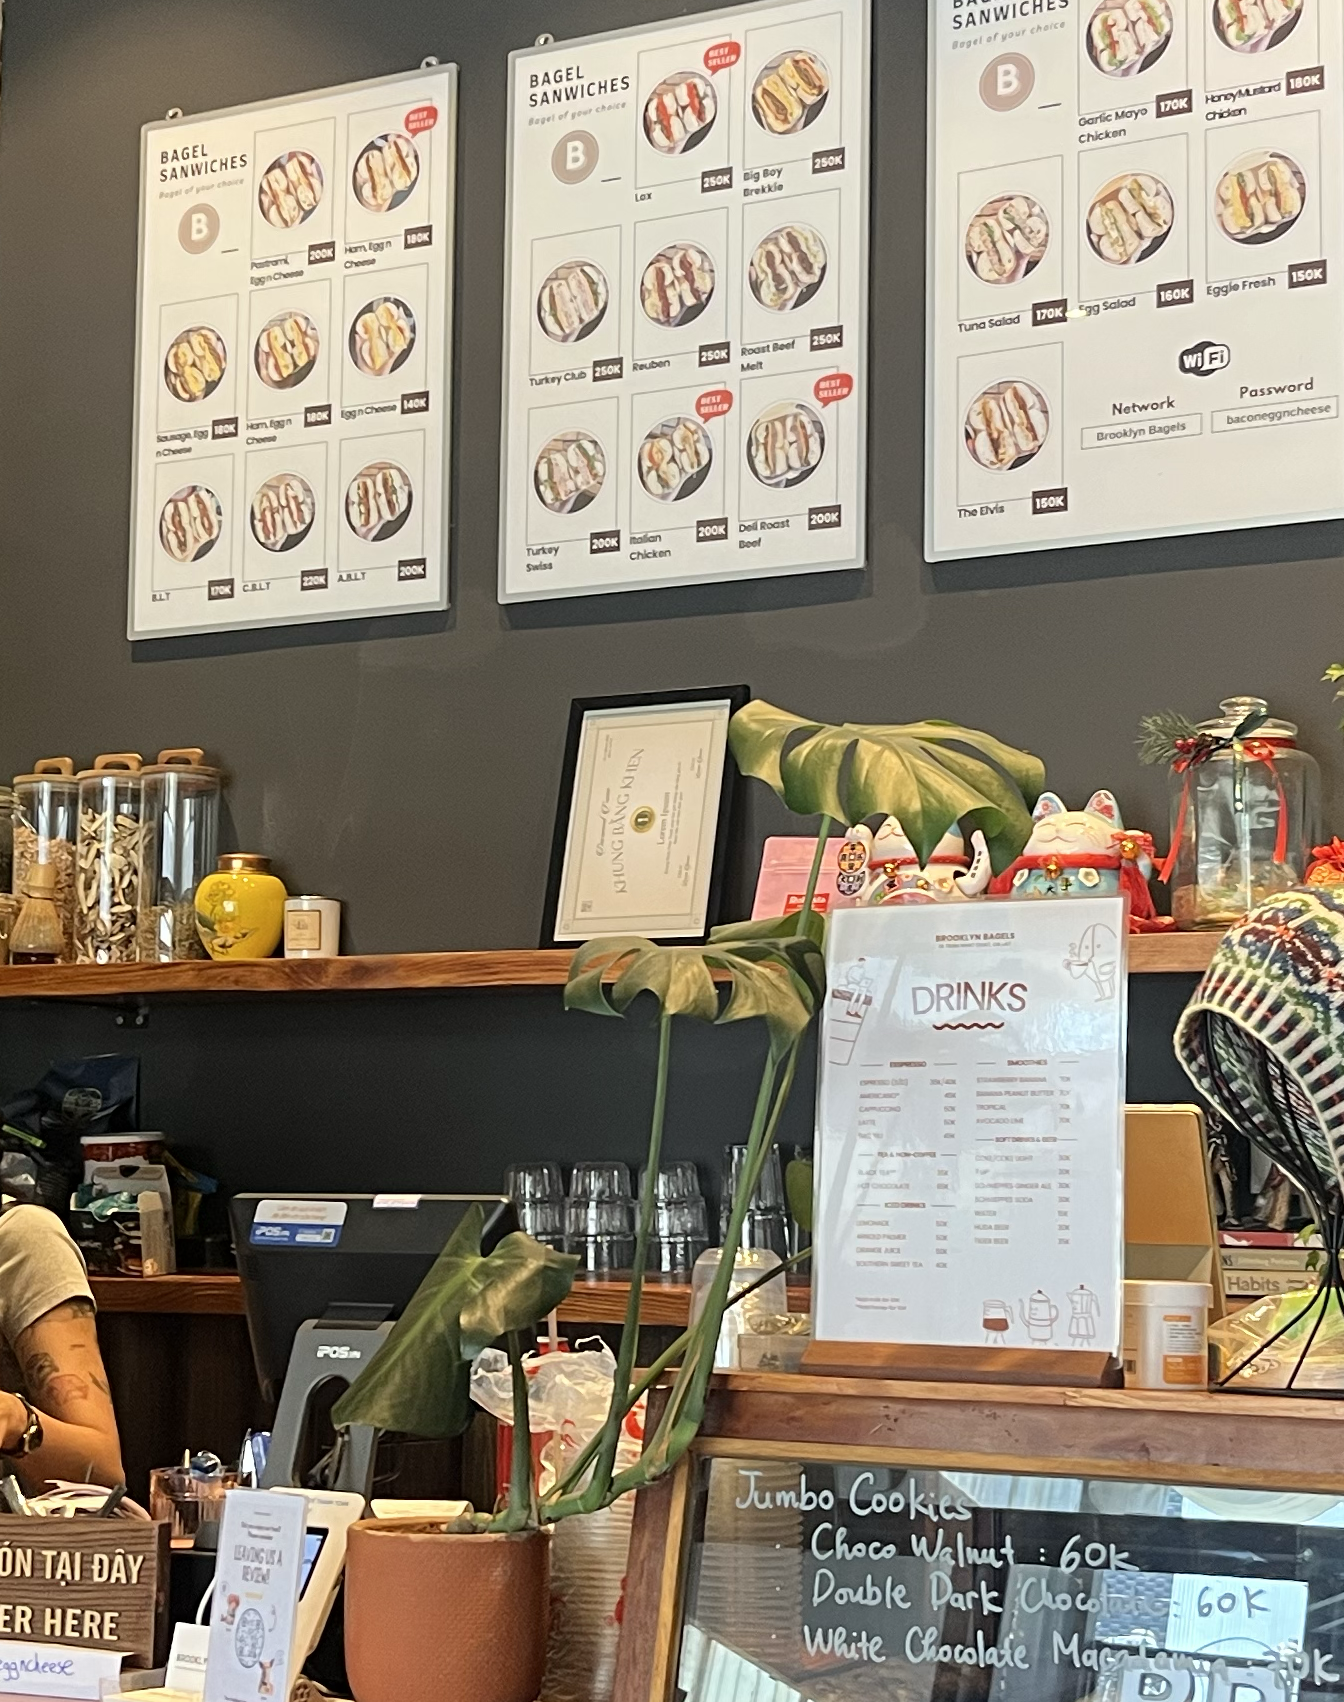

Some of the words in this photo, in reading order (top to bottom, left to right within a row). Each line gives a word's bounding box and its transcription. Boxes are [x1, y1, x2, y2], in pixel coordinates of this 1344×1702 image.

[952, 0, 1069, 30] SANWICHES
[952, 36, 982, 49] Bagel
[986, 33, 998, 43] of
[1001, 29, 1026, 42] your
[1030, 22, 1065, 34] choice
[530, 65, 584, 89] BAGEL
[996, 64, 1020, 96] B
[1289, 74, 1321, 89] 180K
[529, 76, 630, 108] SANWICHES
[1160, 97, 1189, 113] 170K
[529, 111, 555, 126] Bagel
[558, 110, 568, 120] of
[571, 107, 592, 120] your
[595, 102, 626, 114] choice
[1078, 114, 1112, 128] Garlic
[1115, 107, 1148, 123] Mayo
[1078, 127, 1126, 144] Chicken
[161, 144, 208, 164] BAGEL
[566, 140, 586, 171] B
[160, 154, 248, 182] SANWICHES
[814, 155, 842, 169] 250K
[703, 174, 731, 189] 250K
[744, 171, 760, 182] Big
[763, 167, 783, 180] Boy
[159, 187, 182, 200] Bagel
[184, 185, 194, 195] of
[196, 183, 214, 195] your
[217, 178, 244, 189] choice
[635, 191, 652, 202] Lox
[743, 182, 783, 197] Brekkie
[191, 213, 208, 241] B
[407, 229, 430, 244] 180K
[309, 247, 334, 261] 200K
[1292, 268, 1323, 282] 150K
[1242, 275, 1276, 291] Fresh
[1160, 287, 1190, 301] 160K
[1103, 297, 1136, 313] Salad
[1036, 306, 1063, 321] 170K
[958, 319, 985, 333] Tuna
[988, 314, 1020, 330] Salad
[812, 332, 841, 346] 250K
[701, 348, 728, 361] 250K
[741, 344, 770, 356] Roast
[773, 340, 795, 351] Beef
[595, 364, 621, 377] 250K
[632, 359, 670, 372] Reuben
[741, 361, 763, 372] Melt
[529, 374, 562, 387] Turkey
[564, 371, 586, 381] Club
[820, 379, 841, 389] BEST
[819, 386, 849, 399] SELLER
[1240, 378, 1314, 399] Password
[701, 395, 722, 405] BEST
[1112, 396, 1175, 415] Network
[700, 402, 729, 415] SELLER
[1227, 402, 1331, 425] baconeggncheese
[1097, 425, 1145, 443] Brooklyn
[1149, 420, 1186, 437] Bagels
[958, 507, 978, 518] The
[980, 503, 1004, 516] Elvis
[1036, 496, 1064, 510] 150K
[760, 518, 789, 530] Roast
[810, 512, 839, 525] 200K
[698, 524, 726, 537] 200K
[592, 537, 618, 550] 200K
[739, 537, 761, 549] Beef
[526, 545, 559, 558] Turkey
[630, 549, 671, 561] Chicken
[526, 561, 552, 572] Swiss
[912, 981, 1028, 1015] DRINKS
[1227, 1277, 1279, 1291] Habits
[736, 1469, 833, 1511] Jumbo
[849, 1472, 972, 1522] Cookies
[811, 1523, 896, 1560] Choco
[911, 1529, 1014, 1567] Walnut
[42, 1550, 82, 1586] TẠI
[92, 1550, 144, 1584] ĐÂY
[812, 1568, 911, 1609] Double
[930, 1571, 1003, 1615] Dark
[1197, 1586, 1271, 1619] 60K
[45, 1608, 119, 1641] HERE
[803, 1624, 886, 1663] White
[905, 1626, 1030, 1669] Chocolate
